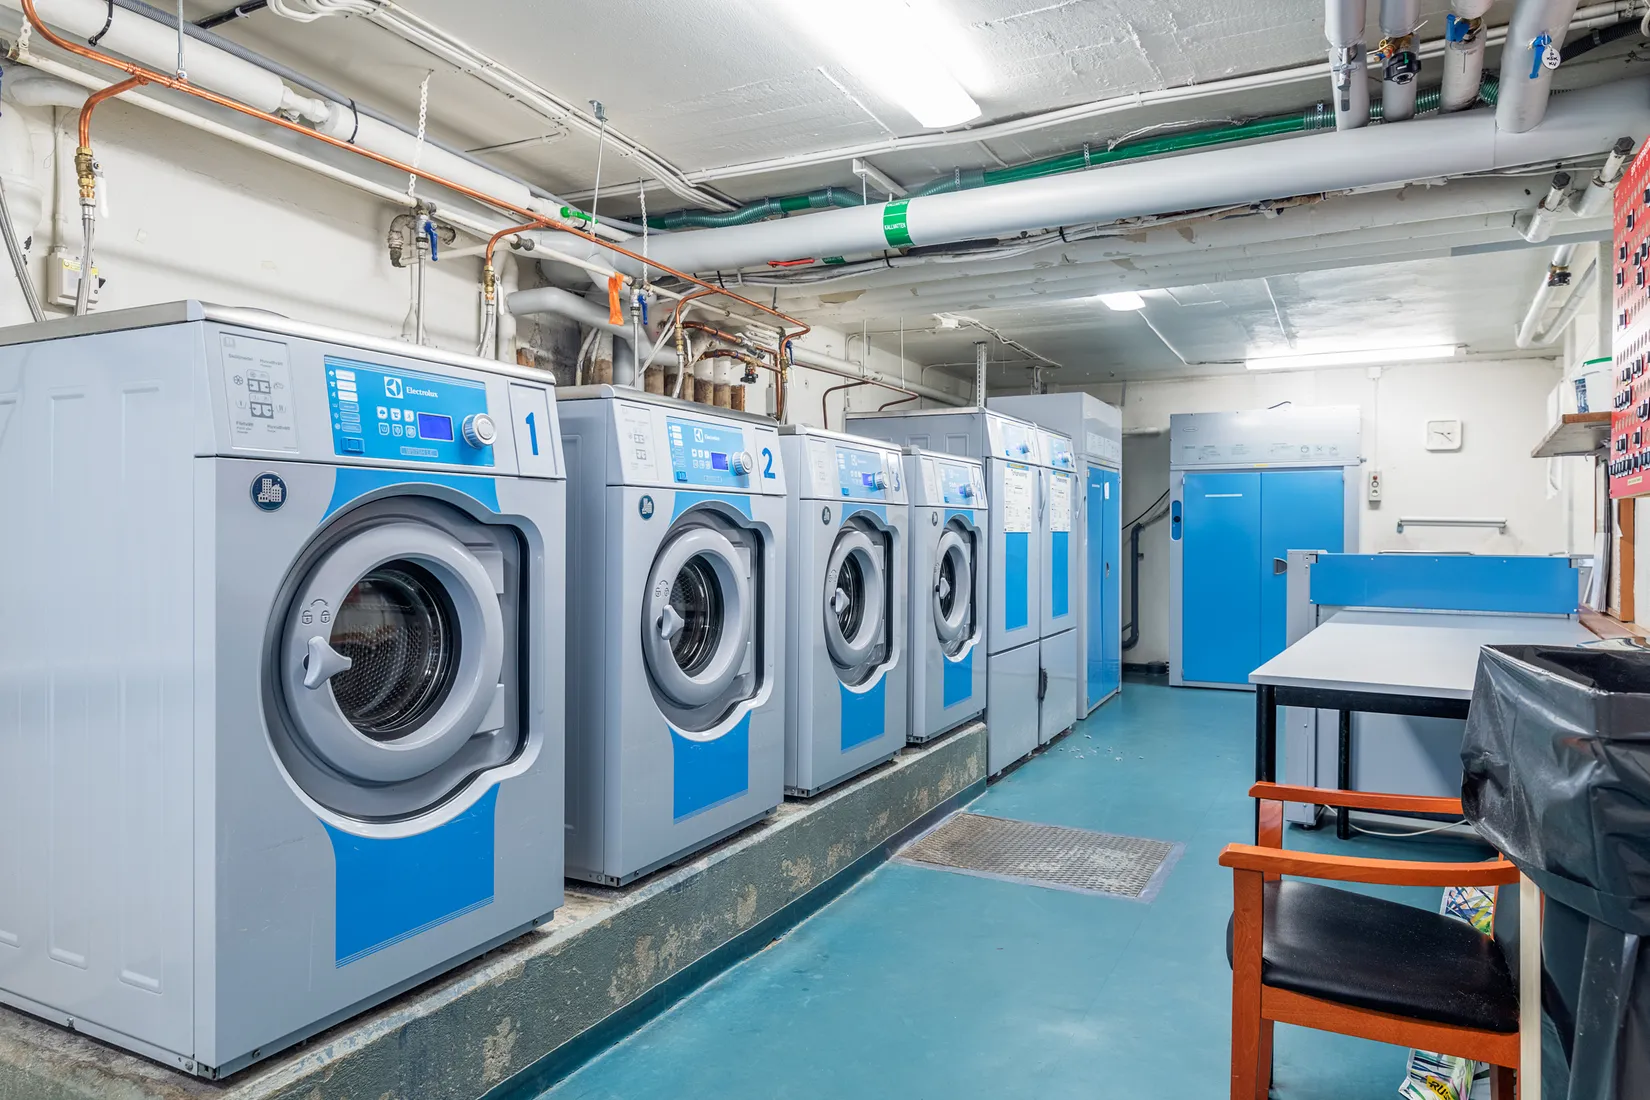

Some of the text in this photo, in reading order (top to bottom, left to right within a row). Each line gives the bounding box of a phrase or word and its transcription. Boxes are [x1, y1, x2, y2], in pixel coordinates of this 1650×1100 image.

[406, 386, 438, 398] Electrolux
[525, 411, 539, 456] 1
[761, 447, 776, 479] 2
